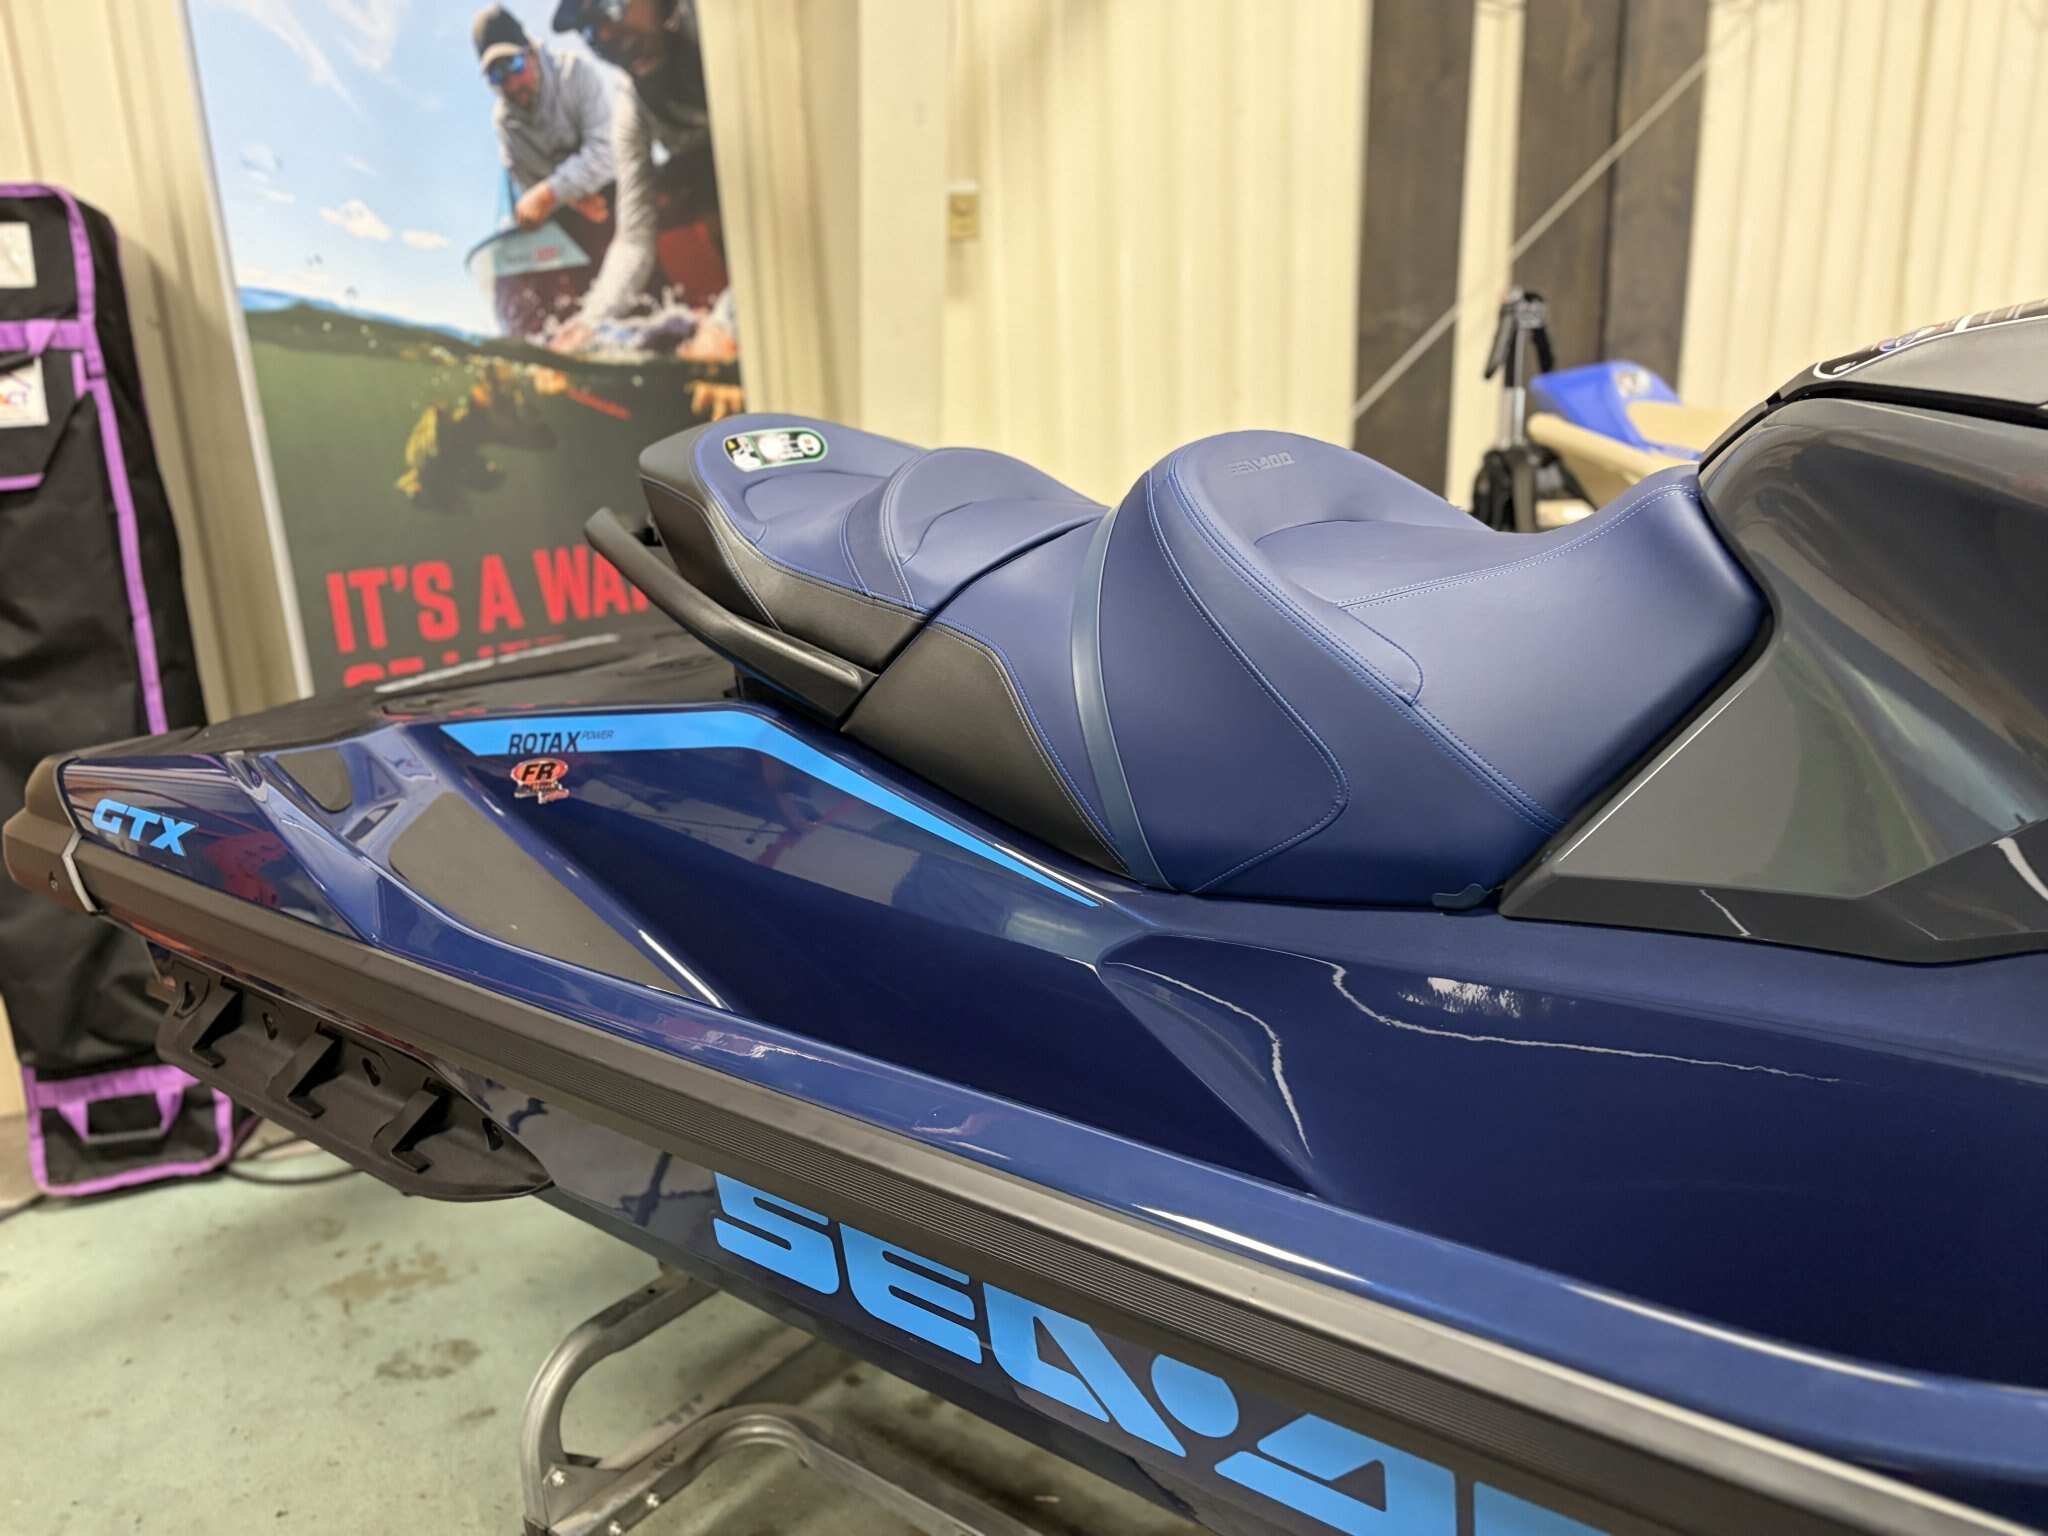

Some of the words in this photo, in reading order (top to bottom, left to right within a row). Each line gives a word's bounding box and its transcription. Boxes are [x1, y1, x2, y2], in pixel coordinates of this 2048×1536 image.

[326, 561, 460, 654] IT'S
[479, 554, 525, 633] A
[533, 544, 648, 624] WA
[508, 730, 581, 755] ROTAX
[581, 729, 614, 740] POWER
[521, 762, 557, 781] FR
[92, 798, 197, 857] GTX
